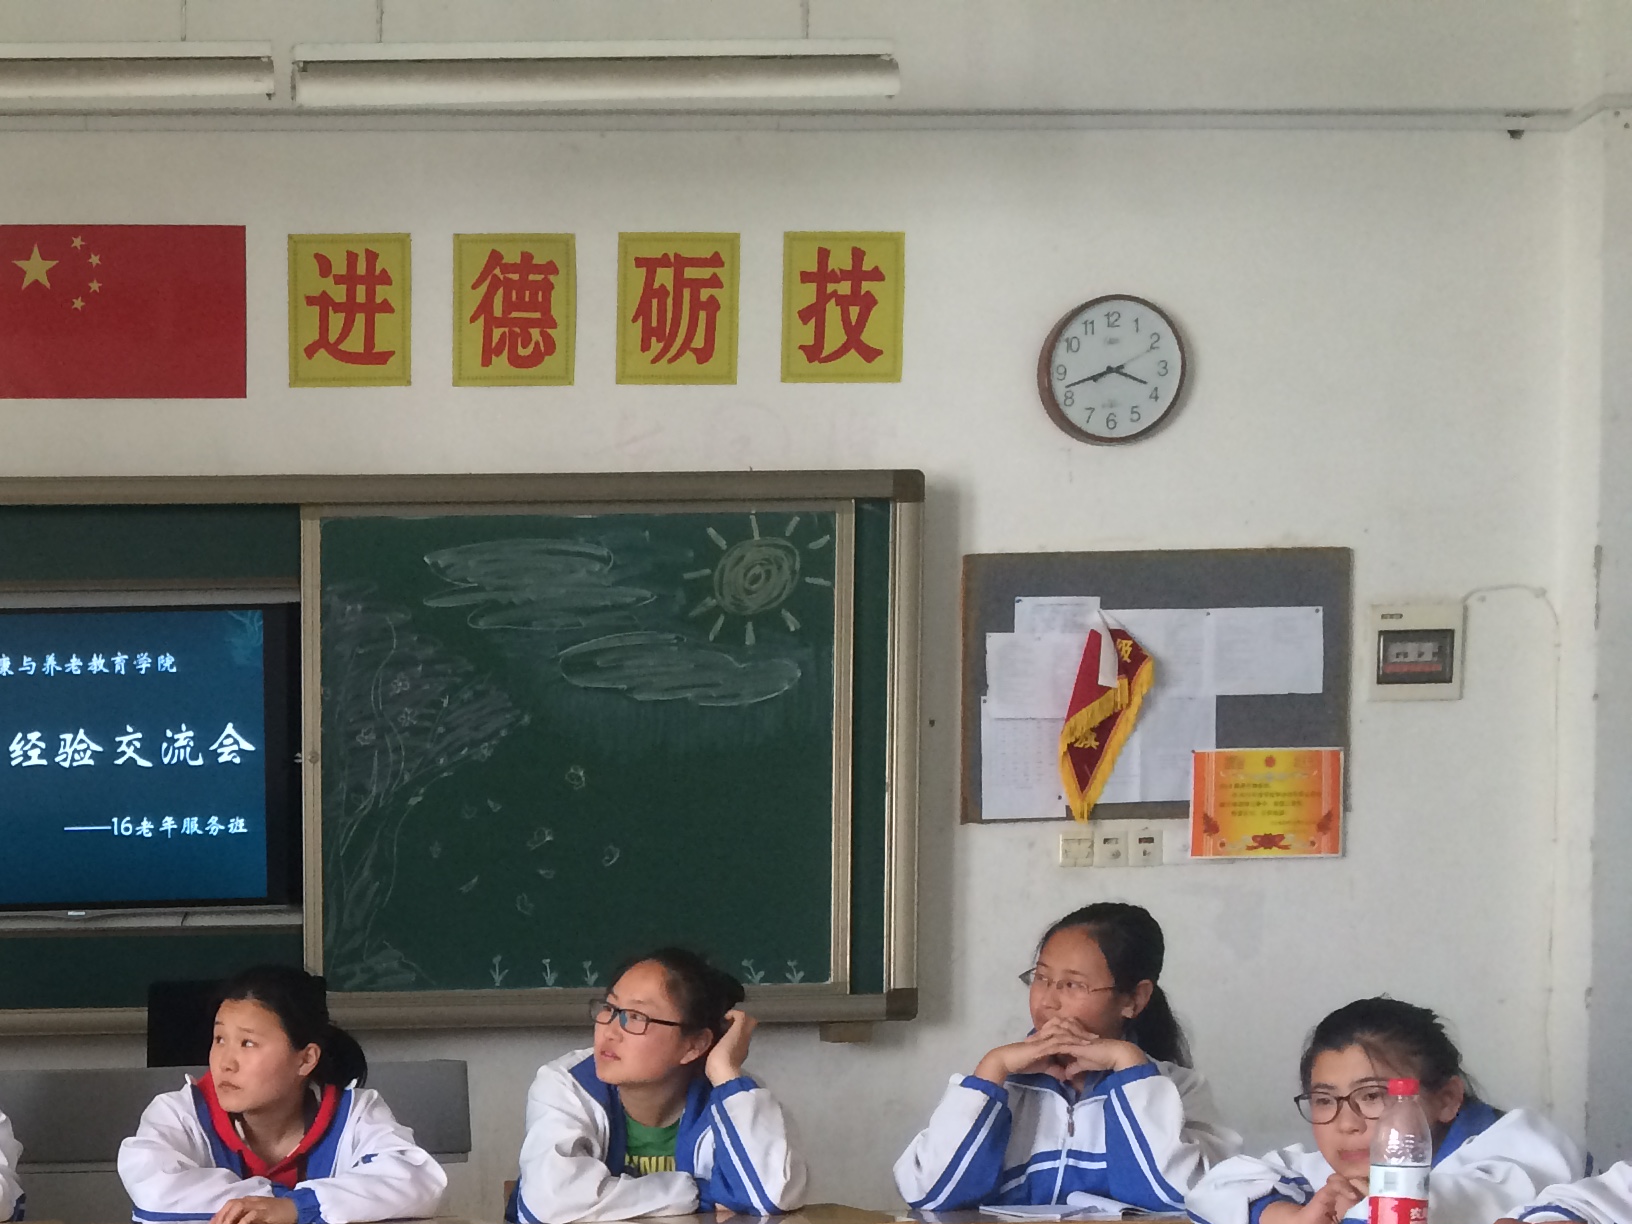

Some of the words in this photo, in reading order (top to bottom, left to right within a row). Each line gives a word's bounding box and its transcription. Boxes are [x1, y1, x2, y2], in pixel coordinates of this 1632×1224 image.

[303, 245, 886, 370] 进德砺技
[1082, 319, 1095, 335] 11
[1104, 311, 1121, 328] 12
[1134, 317, 1139, 333] 1
[1064, 336, 1080, 353] 10
[1150, 332, 1160, 350] 2
[1056, 364, 1067, 381] 9
[1157, 360, 1168, 377] 3
[1063, 390, 1075, 407] 8
[1149, 386, 1160, 402] 4
[1084, 406, 1095, 424] 7
[1106, 412, 1118, 430] 6
[1129, 405, 1141, 423] 5
